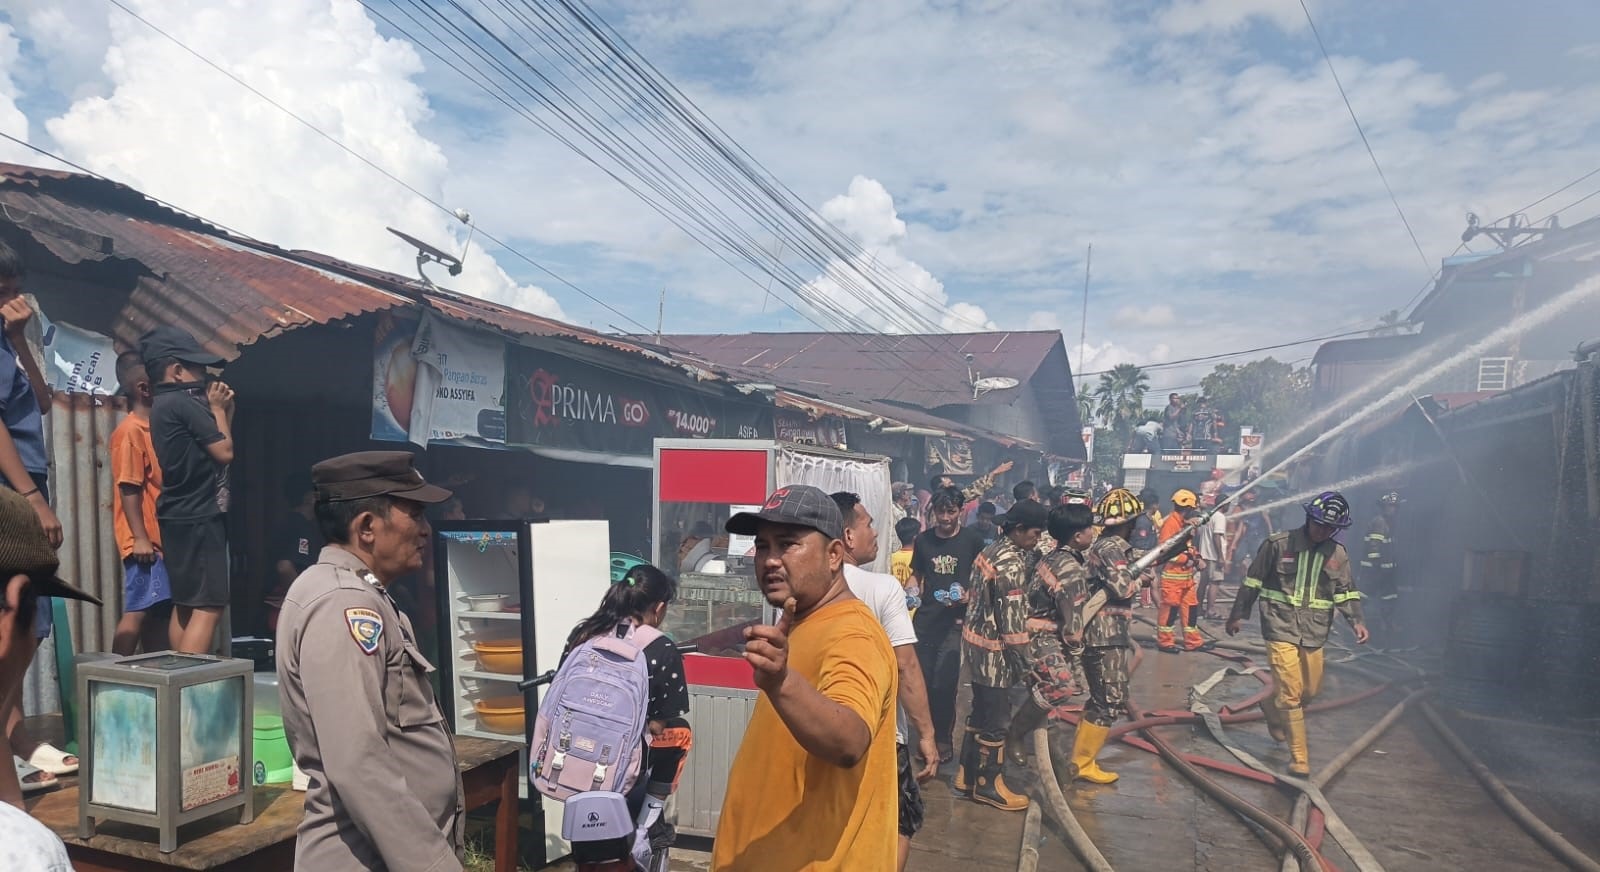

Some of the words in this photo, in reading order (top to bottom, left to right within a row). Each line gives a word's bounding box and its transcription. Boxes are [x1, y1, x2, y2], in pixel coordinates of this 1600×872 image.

[80, 351, 101, 391] Pecah
[450, 388, 476, 402] ASSYIFA
[551, 384, 617, 425] PRIMA
[624, 402, 643, 423] GO
